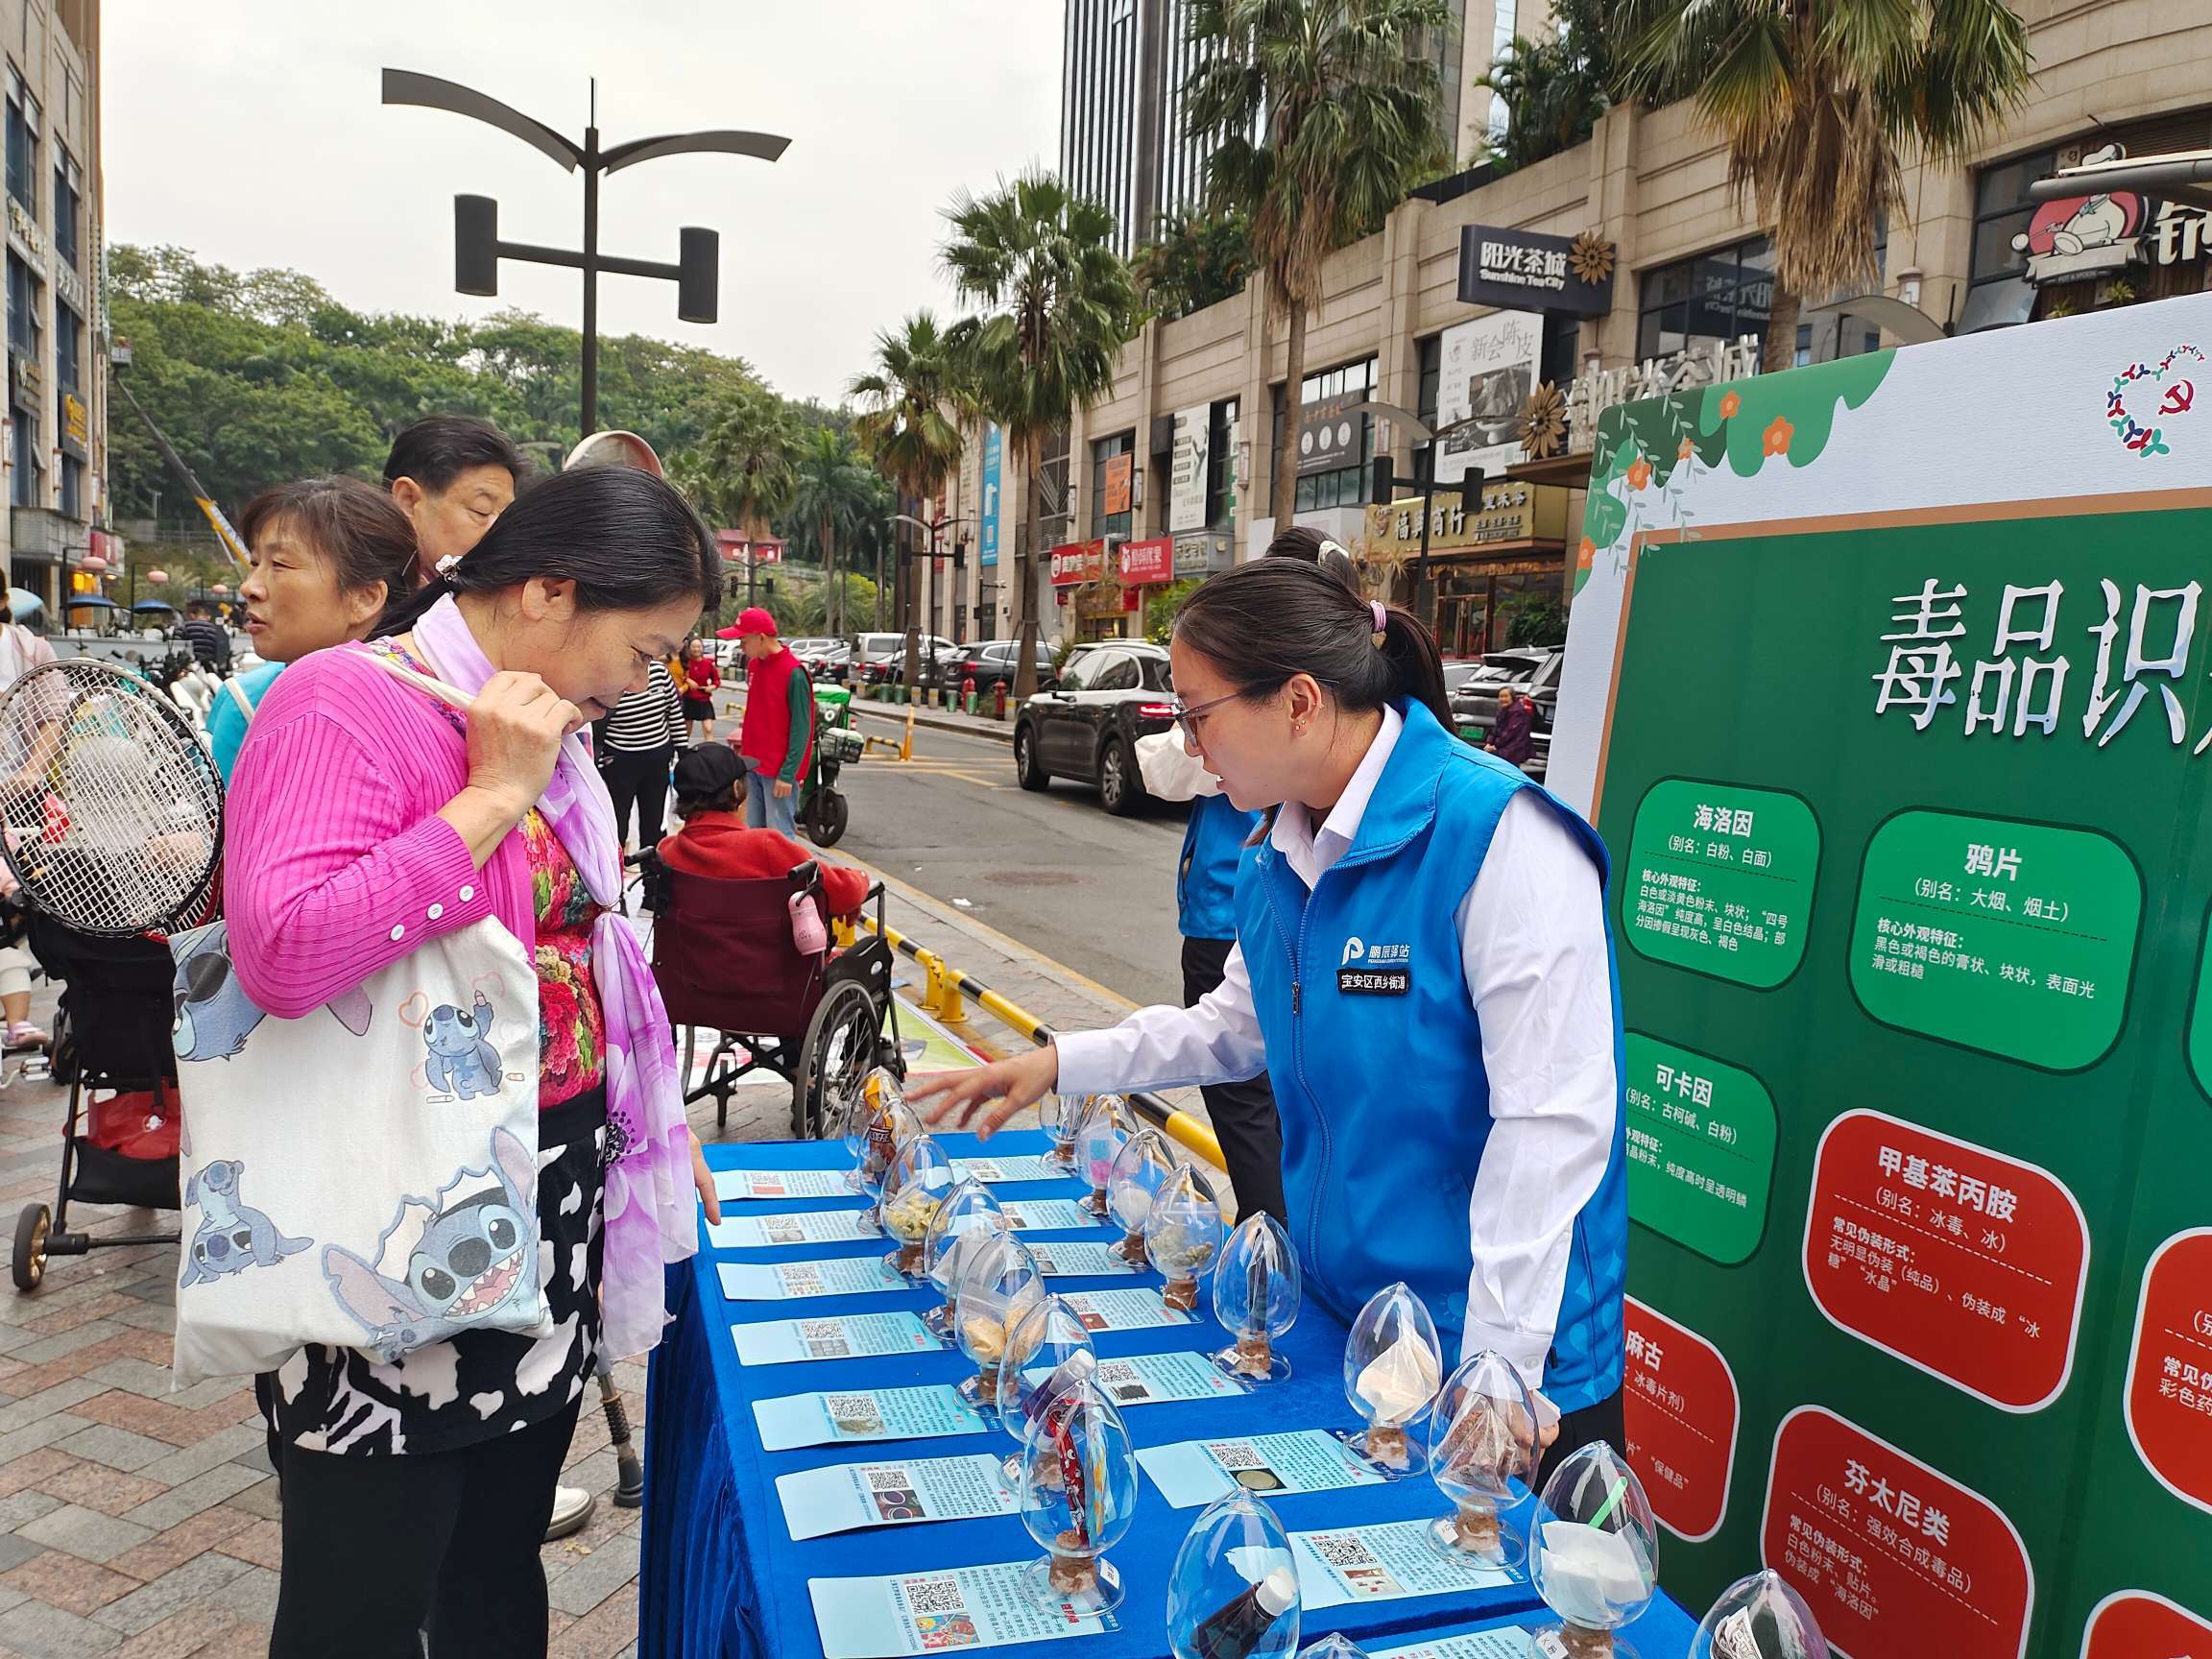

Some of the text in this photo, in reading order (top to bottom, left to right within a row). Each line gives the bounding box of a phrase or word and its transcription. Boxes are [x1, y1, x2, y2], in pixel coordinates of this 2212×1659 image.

[1479, 241, 1567, 276] 阳光茶城
[1872, 578, 2212, 755] 毒品识
[1694, 805, 1753, 837] 海洛因
[1669, 834, 1772, 868] （别名：白粉、白面）
[1964, 844, 2022, 881] 鸦片
[1642, 869, 1701, 892] 核心外观特征：
[1915, 878, 2068, 922] （别名：大烟、烟土）
[1877, 917, 1964, 949] 核心外观特征：
[1341, 974, 1406, 990] 宝安区西乡街道
[1871, 954, 1924, 979] 滑或粗糙
[1874, 936, 2095, 998] 黑色或褐色的膏状、块状，表面光
[1656, 1064, 1713, 1108] 可卡因
[1878, 1145, 2017, 1223] 甲基苯丙胺
[1833, 1216, 1915, 1262] 常见伪装形式：
[1876, 1186, 2007, 1252] （别名：冰毒、冰）
[1624, 1330, 1663, 1371] 麻古
[2159, 1378, 2212, 1416] 彩色药
[1844, 1458, 1951, 1547] 芬太尼类
[1791, 1514, 1868, 1575] 常见伪装形式：
[1816, 1483, 1971, 1593] （别名：强效合成毒品）
